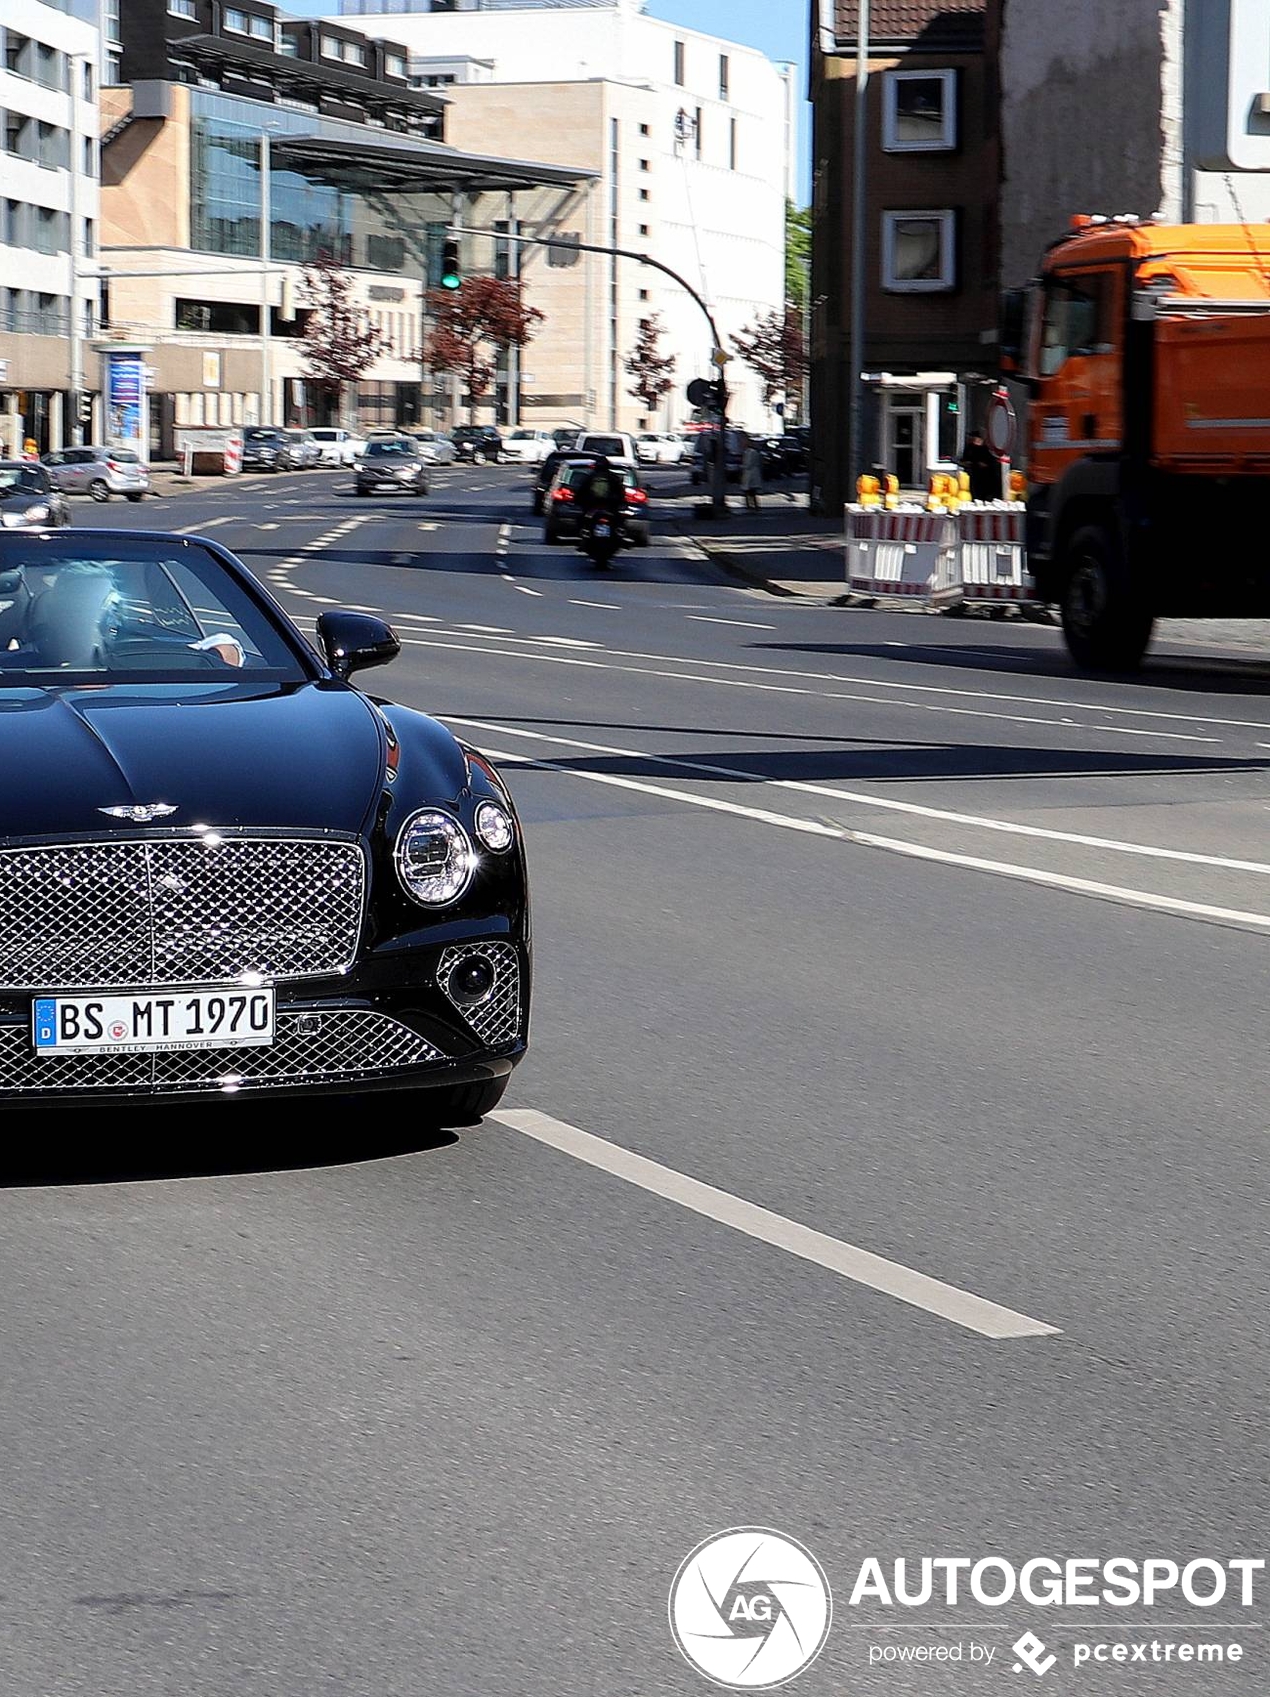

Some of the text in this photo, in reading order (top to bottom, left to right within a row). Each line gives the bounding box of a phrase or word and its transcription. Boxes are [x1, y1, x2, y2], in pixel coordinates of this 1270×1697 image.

[60, 995, 268, 1040] BS MT 1970
[41, 1027, 51, 1039] D
[99, 1041, 213, 1053] BENTLEY HANNOVER
